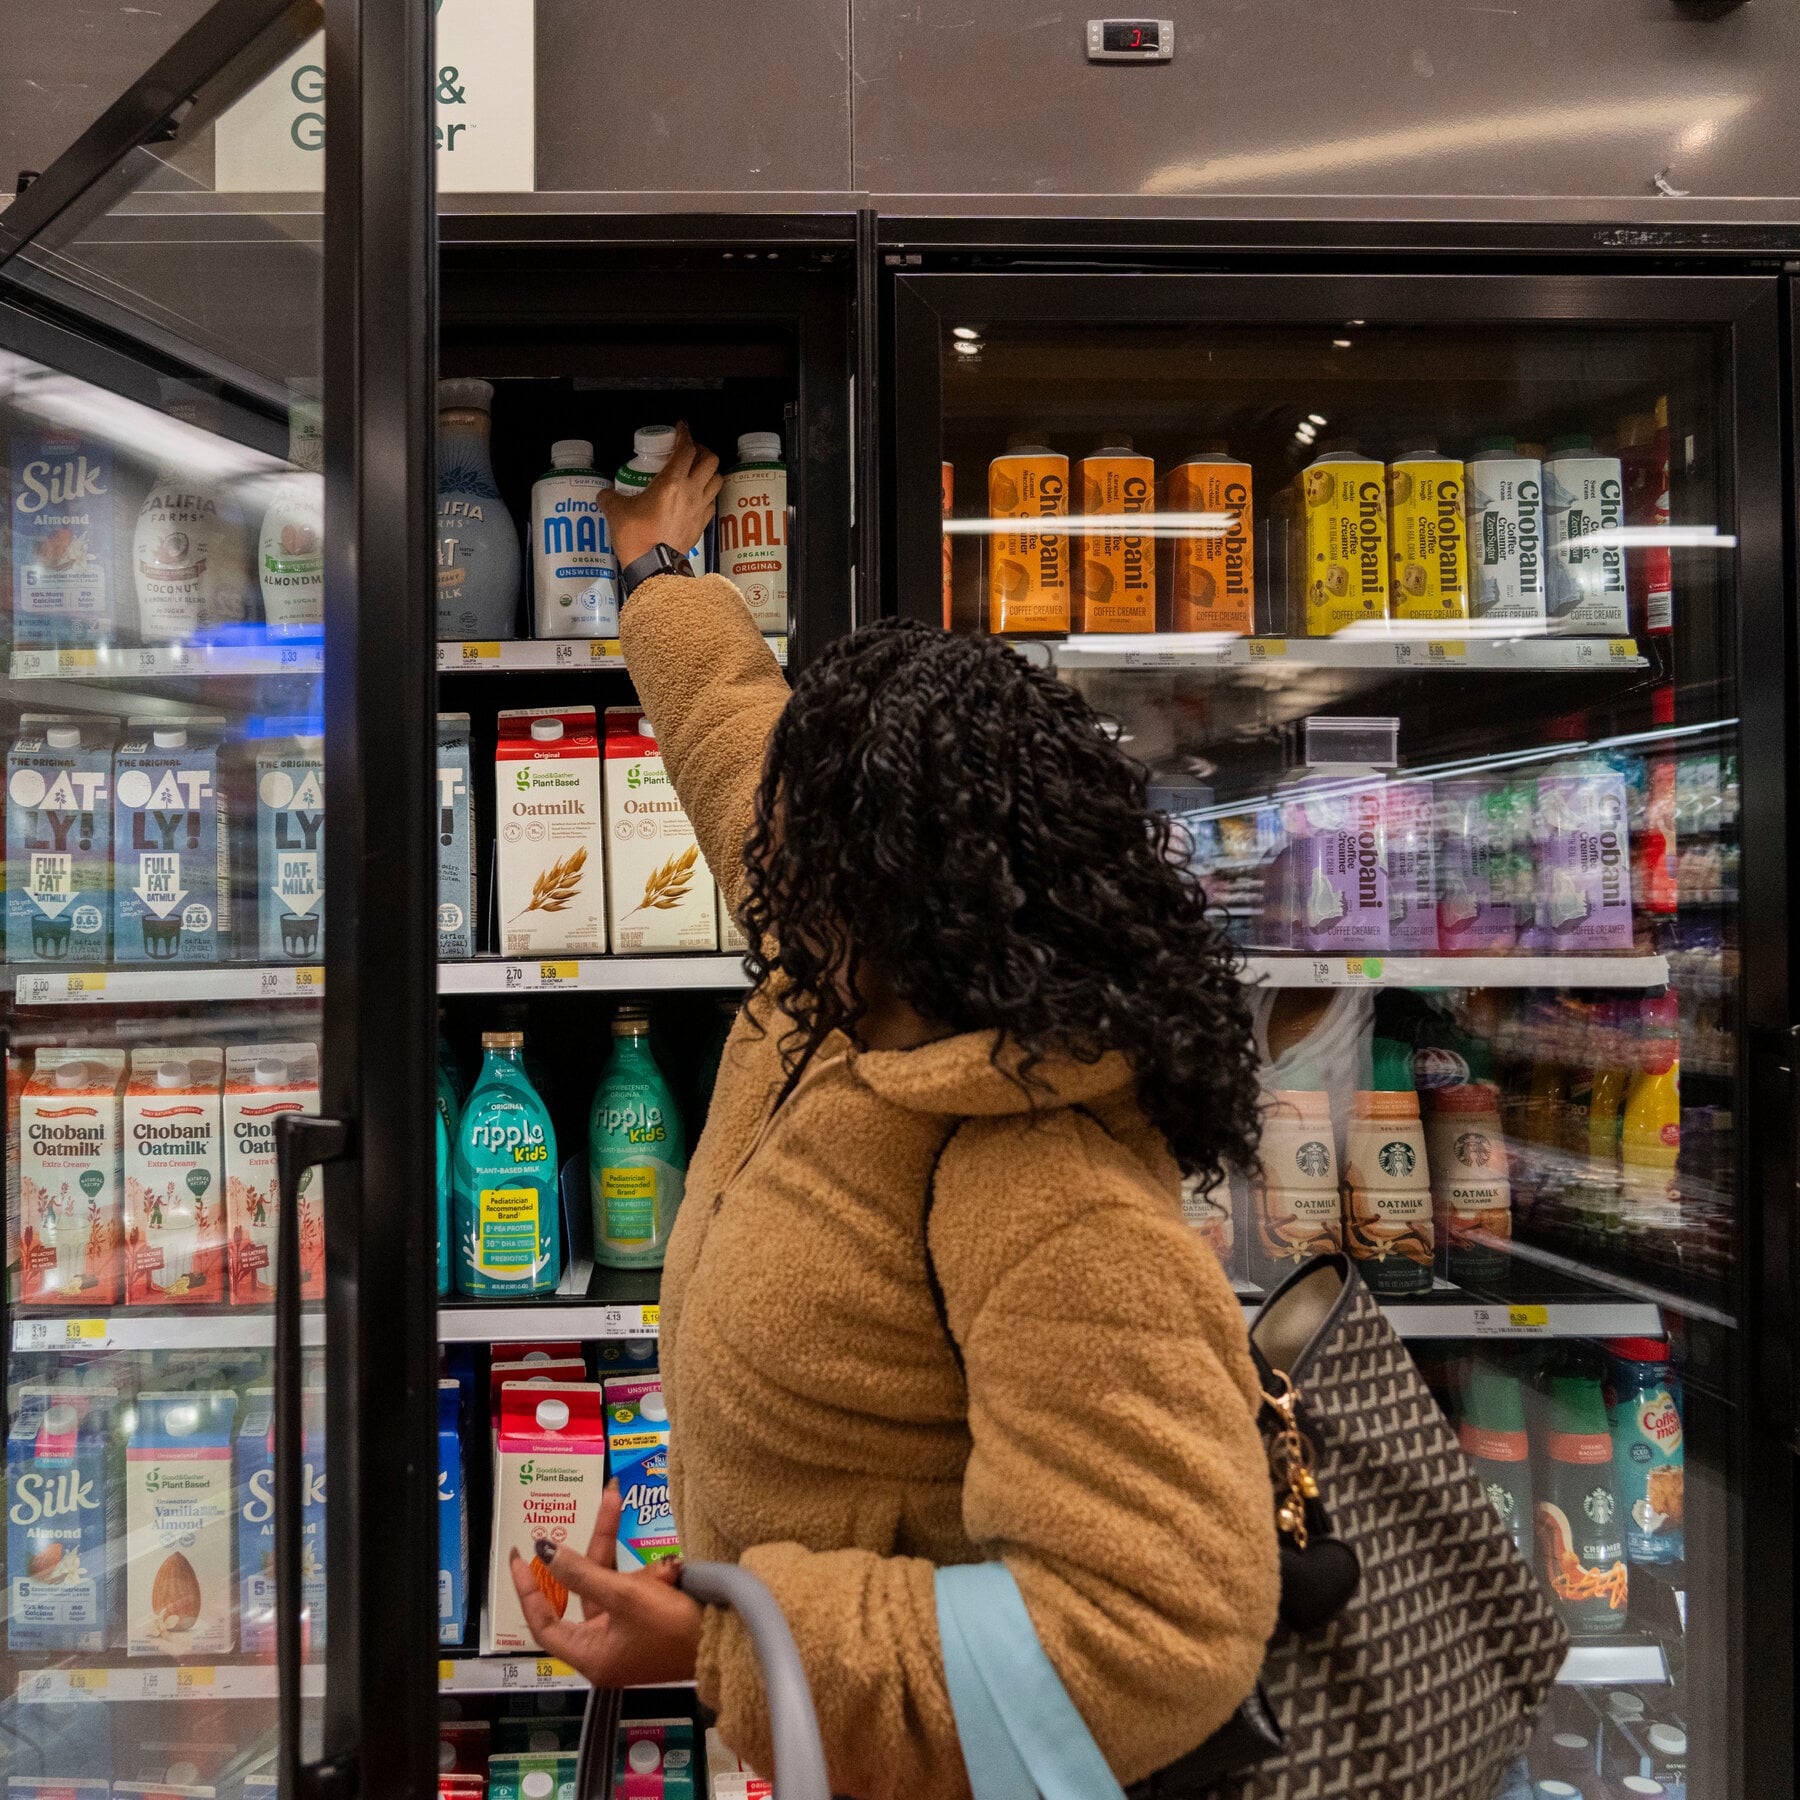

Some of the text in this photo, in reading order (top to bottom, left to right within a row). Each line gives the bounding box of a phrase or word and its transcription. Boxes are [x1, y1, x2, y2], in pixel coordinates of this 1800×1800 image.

[436, 66, 466, 105] &
[16, 456, 107, 513] Silk
[738, 494, 770, 508] oat
[34, 514, 89, 526] Almond
[151, 513, 197, 521] FARMS
[544, 516, 614, 555] MAL
[1224, 483, 1249, 595] Chobani
[1341, 517, 1349, 560] Creamer
[1350, 522, 1358, 555] Coffee
[1359, 482, 1384, 593] Chobani
[1418, 516, 1427, 560] Creamer
[1427, 522, 1436, 555] Coffee
[1437, 480, 1463, 592] Chobani
[1498, 517, 1507, 561] Creamer
[1507, 522, 1517, 556] Coffee
[1517, 480, 1543, 593] Chobani
[737, 551, 775, 559] ORGANIC
[560, 568, 614, 578] UNSWEETENED
[736, 563, 778, 573] ORIGINAL
[27, 571, 38, 585] 5
[147, 583, 199, 593] COCONUT
[1010, 605, 1063, 615] COFFEE CREAMER
[1094, 607, 1146, 616] COFFEE CREAMER
[1332, 610, 1383, 619] COFFEE CREAMER
[1410, 610, 1462, 619] COFFEE CREAMER
[1570, 610, 1622, 620] COFFEE CREAMER
[1196, 611, 1248, 621] COFFEE CREAMER
[463, 649, 478, 659] 5.49
[591, 647, 606, 656] 7.39
[1249, 645, 1265, 655] 5.99
[1395, 646, 1410, 656] 7.99
[1576, 646, 1592, 656] 7.99
[1609, 646, 1624, 656] 5.99
[139, 654, 155, 665] 3.33
[281, 651, 297, 662] 3.33
[534, 752, 560, 760] Original
[10, 758, 76, 767] THE ORIGINAL
[139, 759, 182, 767] ORIGINAL
[281, 760, 323, 768] ORIGINAL
[532, 779, 580, 787] Plant Based
[643, 777, 665, 785] Plant
[10, 769, 107, 811] OAT-
[117, 769, 213, 809] OAT-
[260, 770, 325, 810] OA
[512, 800, 585, 816] Oatmilk
[25, 811, 93, 851] LY!
[133, 811, 200, 850] LY!
[1338, 831, 1348, 875] Creamer
[1347, 836, 1357, 869] Coffee
[1358, 795, 1383, 908] Chobani
[1600, 794, 1626, 907] Chobani
[36, 858, 67, 874] FULL
[145, 858, 175, 874] FULL
[284, 862, 311, 879] OAT-
[38, 875, 62, 892] FAT
[148, 875, 171, 891] FAT
[282, 879, 315, 895] MILK
[37, 893, 67, 903] OATMILK
[147, 893, 176, 902] OATMILK
[76, 916, 99, 925] 0.63
[186, 914, 208, 923] 0.63
[1328, 926, 1381, 936] COFFEE CREAMER
[1573, 925, 1625, 935] COFFEE CREAMER
[506, 969, 522, 979] 2.70
[540, 968, 556, 979] 5.39
[1313, 964, 1329, 974] 7.99
[1347, 964, 1363, 974] 5.99
[68, 981, 83, 990] 5.99
[262, 976, 278, 986] 3.00
[296, 975, 312, 985] 5.99
[33, 982, 48, 991] 3.00
[491, 1103, 523, 1111] ORIGINAL
[596, 1103, 662, 1133] ripple
[28, 1124, 105, 1140] Chobani
[133, 1123, 211, 1139] Chobani
[472, 1119, 544, 1153] ripple
[629, 1127, 666, 1143] Kids
[33, 1141, 101, 1156] Oatmilk
[138, 1141, 207, 1156] Oatmilk
[514, 1145, 547, 1162] Kids
[42, 1160, 91, 1168] Extra Creamy
[147, 1160, 197, 1168] Extra Creamy
[524, 1166, 540, 1174] MILK
[187, 1175, 210, 1183] NATURAL
[606, 1181, 650, 1189] Recommended
[1453, 1189, 1499, 1198] OATMILK
[486, 1204, 533, 1212] Recommended
[1295, 1200, 1336, 1208] OATMILK
[1378, 1200, 1423, 1208] OATMILK
[642, 1314, 659, 1322] 6.19
[613, 1437, 632, 1447] 50%
[536, 1473, 584, 1482] Plant Based
[185, 1480, 210, 1488] Based
[10, 1469, 100, 1526] Silk
[155, 1505, 200, 1517] Vanilla
[523, 1499, 577, 1513] Original
[523, 1513, 576, 1524] Almond
[152, 1519, 203, 1530] Almond
[27, 1528, 81, 1539] Almond
[19, 1583, 30, 1597] 5
[503, 1666, 518, 1678] 1.65
[536, 1665, 552, 1676] 3.29
